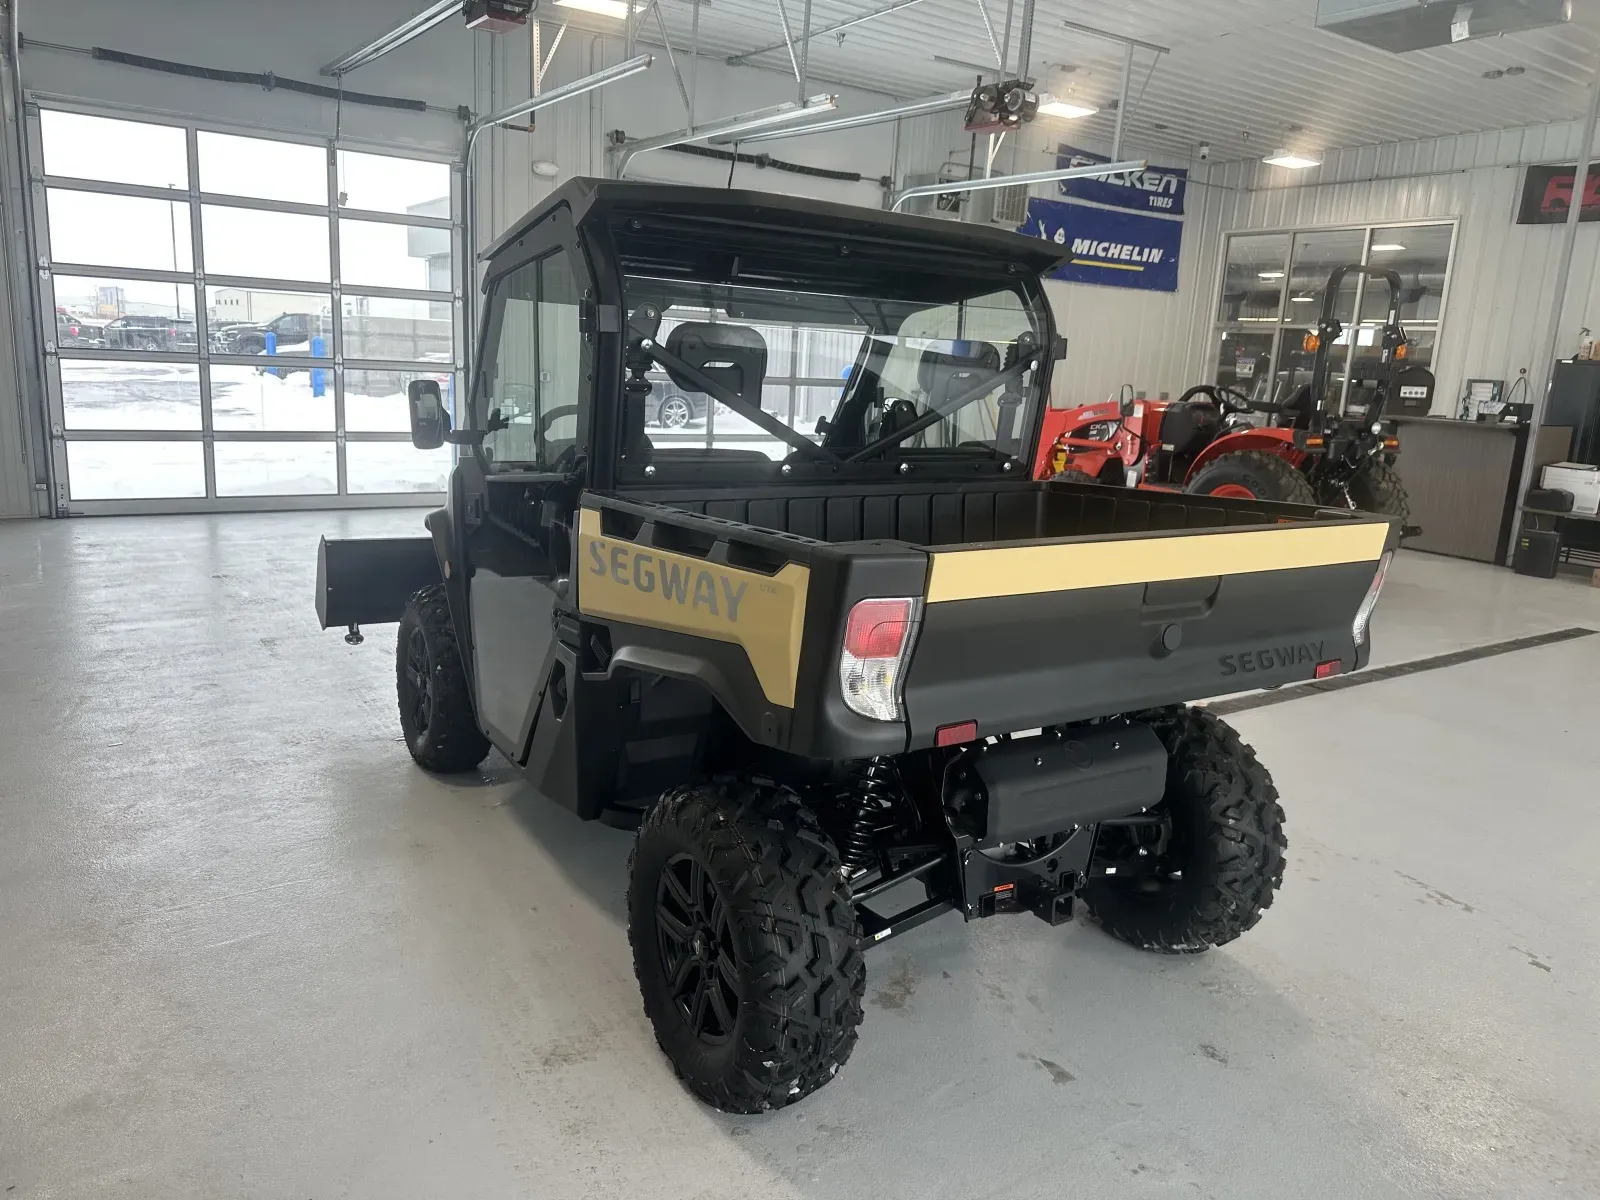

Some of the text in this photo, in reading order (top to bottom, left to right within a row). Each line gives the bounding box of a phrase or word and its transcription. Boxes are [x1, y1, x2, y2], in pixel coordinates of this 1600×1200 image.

[1069, 155, 1178, 195] FLKEN
[1148, 195, 1173, 209] TIRES
[1071, 238, 1164, 264] MICHELIN
[589, 541, 748, 622] SEGWAY
[1219, 641, 1324, 676] SEGWAY
